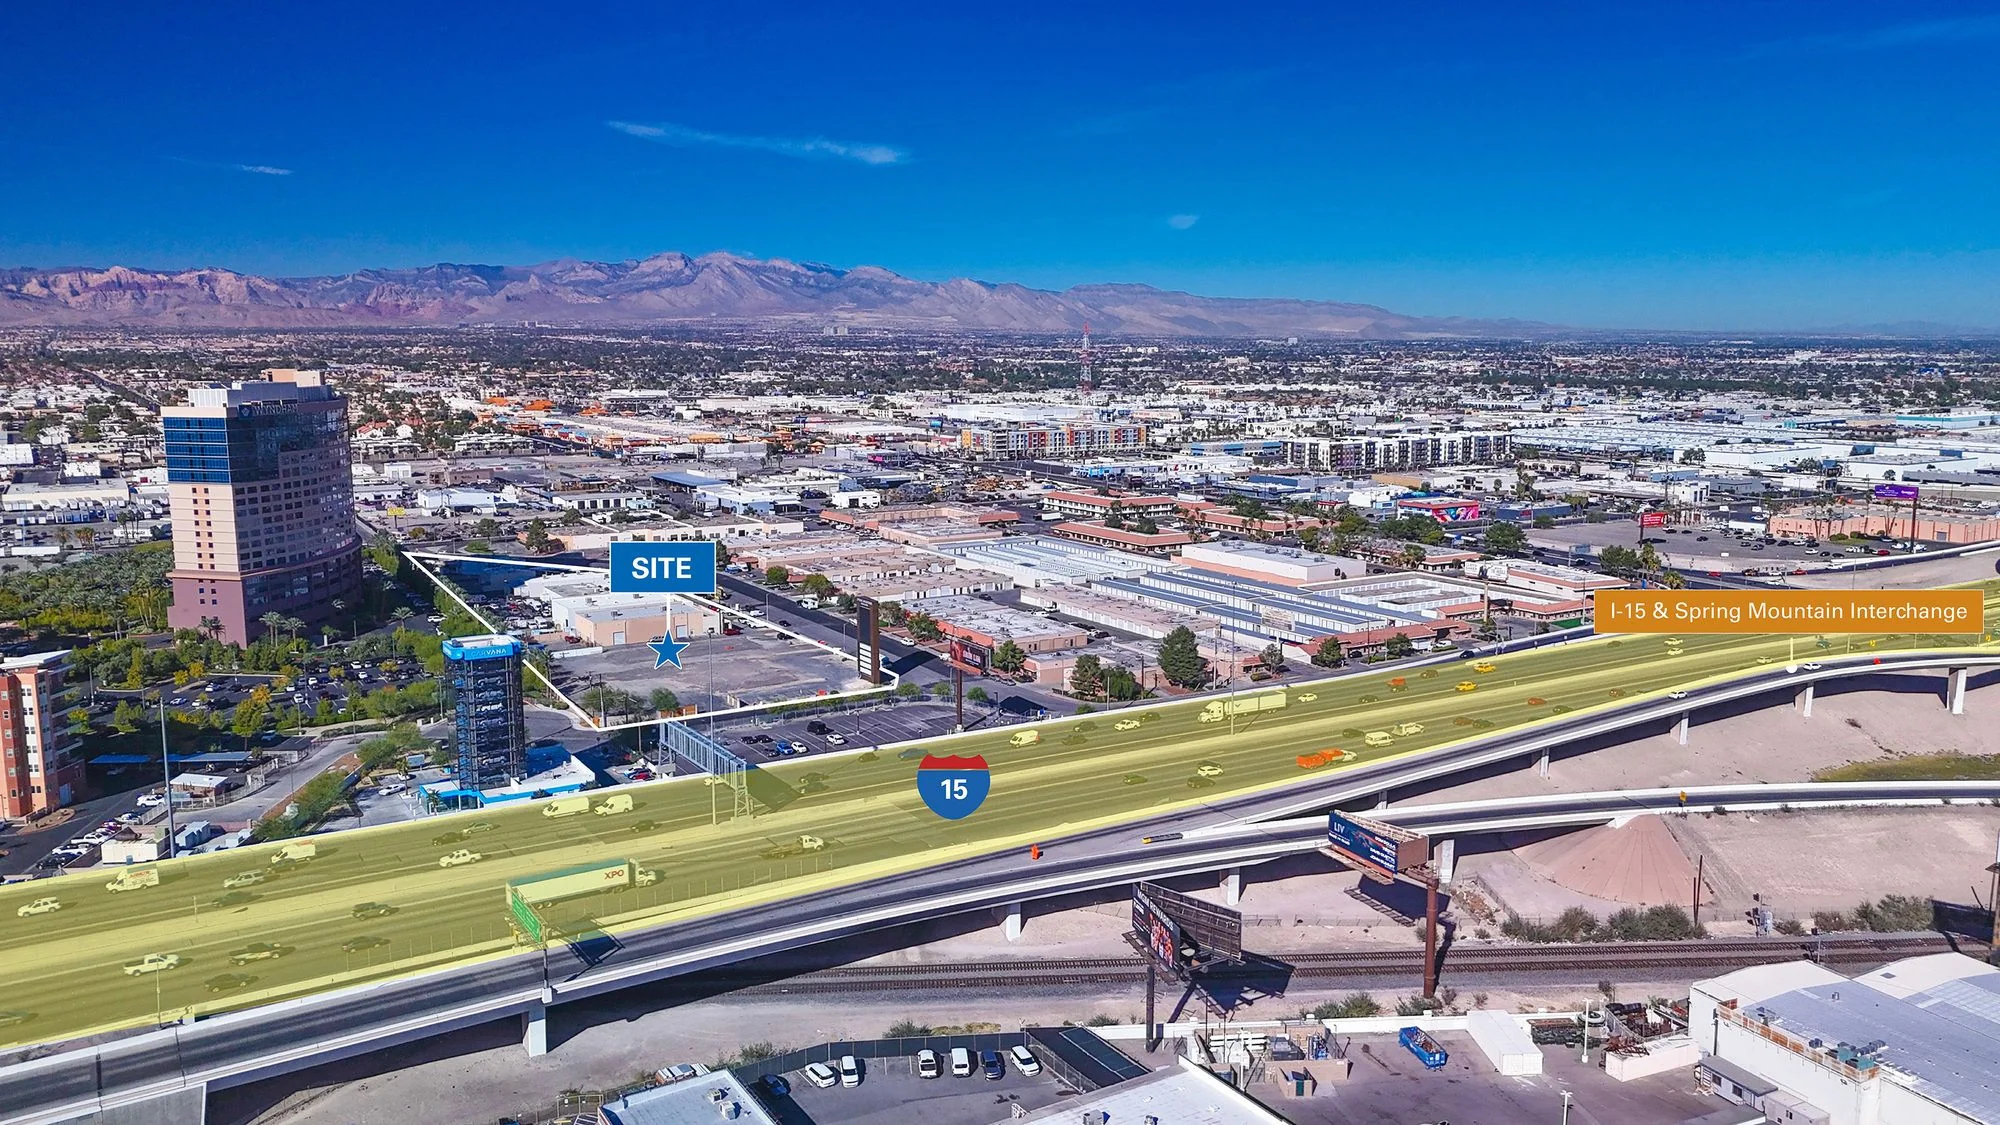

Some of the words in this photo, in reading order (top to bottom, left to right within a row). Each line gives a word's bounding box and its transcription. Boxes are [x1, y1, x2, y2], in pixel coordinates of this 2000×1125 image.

[253, 404, 298, 415] WYNDHAM
[470, 648, 507, 656] CARVANA
[1333, 822, 1345, 834] LIV
[604, 869, 625, 880] XPO
